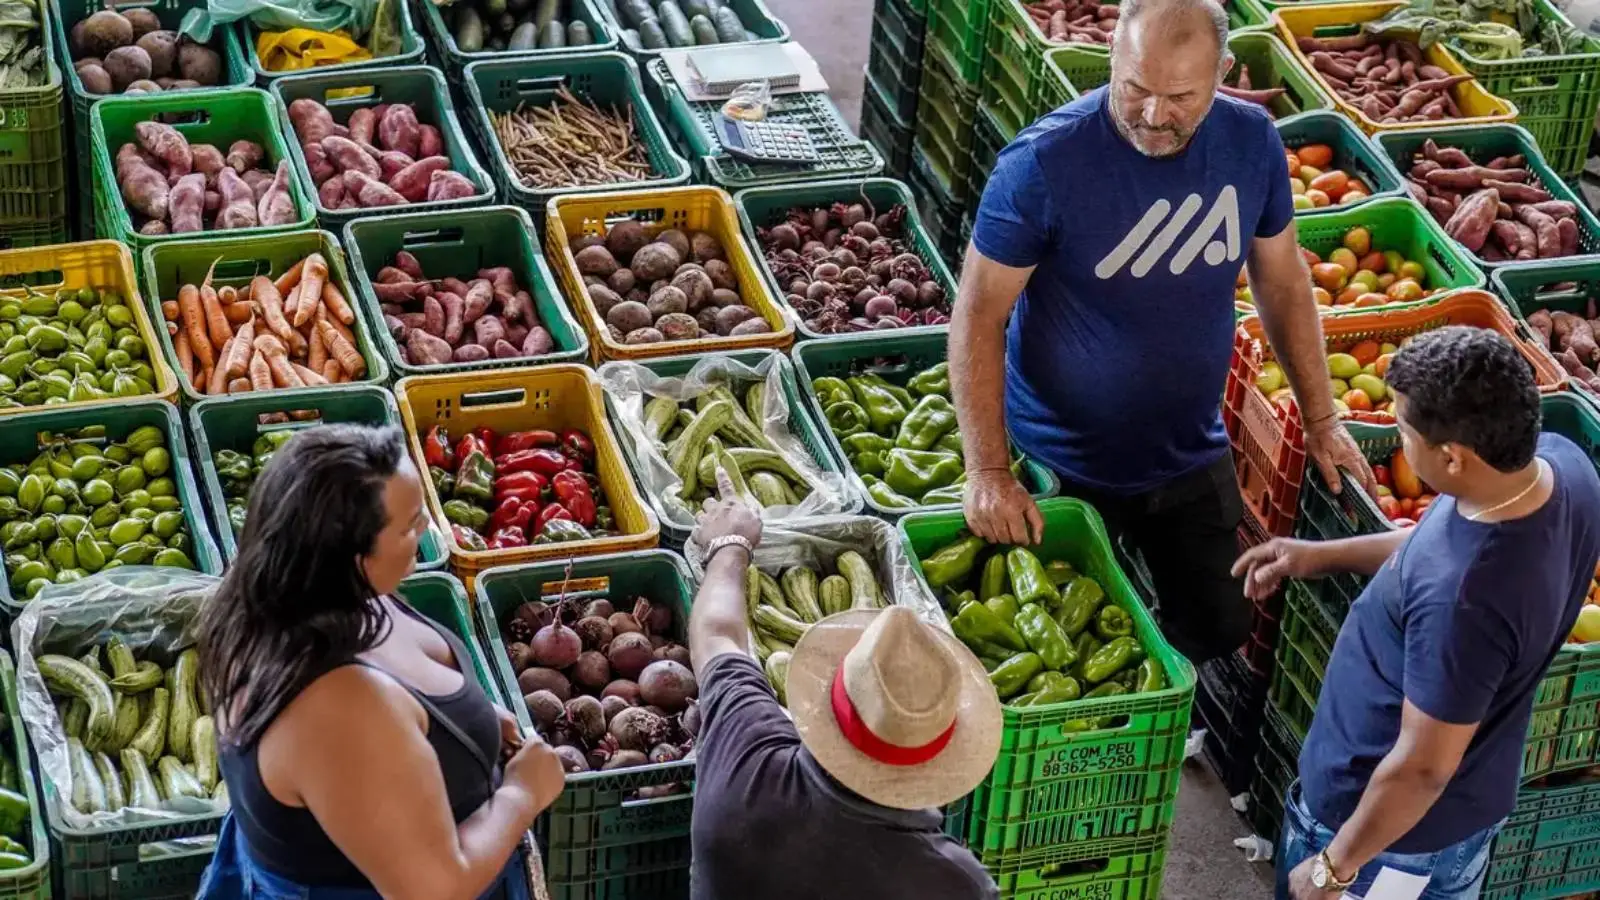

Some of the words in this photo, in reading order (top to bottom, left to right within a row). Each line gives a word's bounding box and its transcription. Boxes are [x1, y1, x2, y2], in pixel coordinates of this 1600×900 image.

[1106, 741, 1136, 756] PEU
[1042, 754, 1136, 777] 98362-5250
[1085, 880, 1113, 896] PEU
